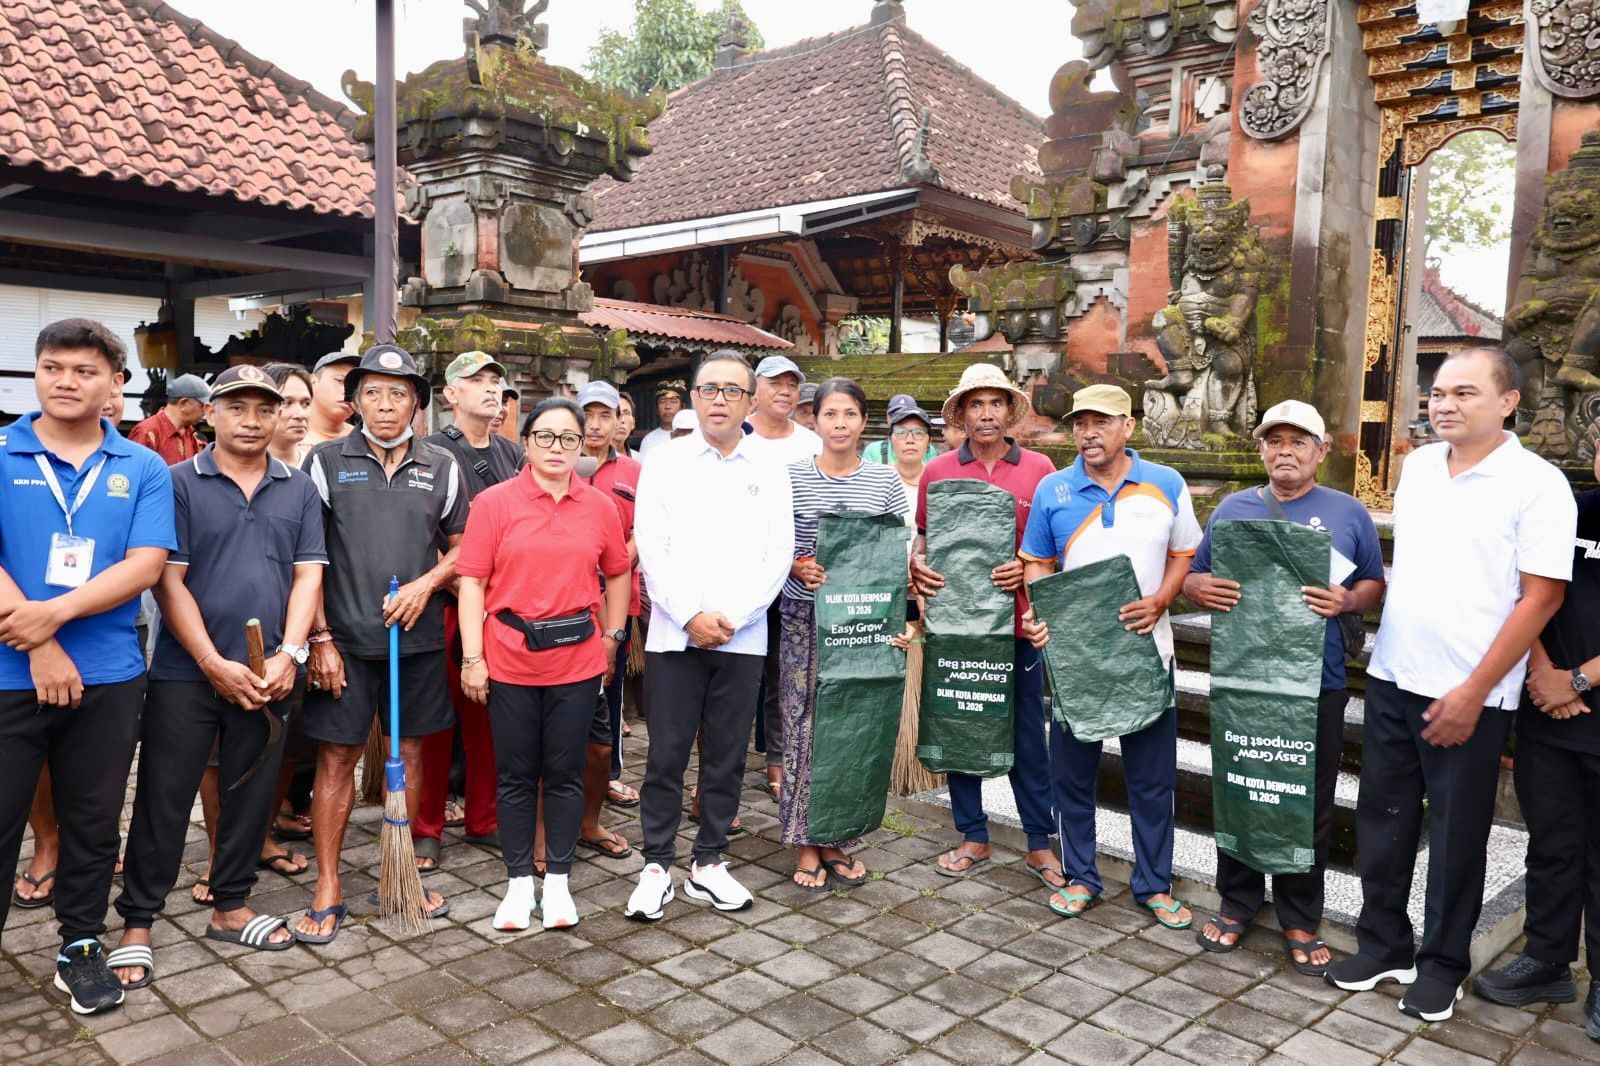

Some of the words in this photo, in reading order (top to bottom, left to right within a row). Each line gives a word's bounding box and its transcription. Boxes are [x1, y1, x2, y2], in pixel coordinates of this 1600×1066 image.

[825, 594, 843, 604] DLHK
[843, 593, 860, 603] KOTA
[860, 592, 892, 603] DENPASAR
[846, 606, 855, 615] TA
[855, 605, 872, 615] 2026
[831, 624, 855, 635] Easy
[856, 622, 883, 633] Grow
[824, 636, 872, 648] Compost
[874, 633, 892, 645] Bag
[938, 658, 959, 670] Bag
[960, 659, 1014, 671] Compost
[949, 671, 979, 682] Grow
[981, 671, 1007, 683] Easy
[936, 687, 955, 698] DLHK
[955, 690, 972, 700] KOTA
[972, 691, 1006, 703] DENPASAR
[957, 701, 966, 711] TA
[966, 702, 984, 712] 2026
[1224, 730, 1248, 746] Bag
[1250, 735, 1315, 752] Compost
[1238, 748, 1274, 762] Grow
[1274, 751, 1307, 766] Easy
[1227, 772, 1245, 786] DLHK
[1245, 777, 1265, 790] KOTA
[1266, 779, 1307, 796] DENPASAR
[1248, 790, 1258, 802] TA
[1259, 792, 1280, 805] 2026
